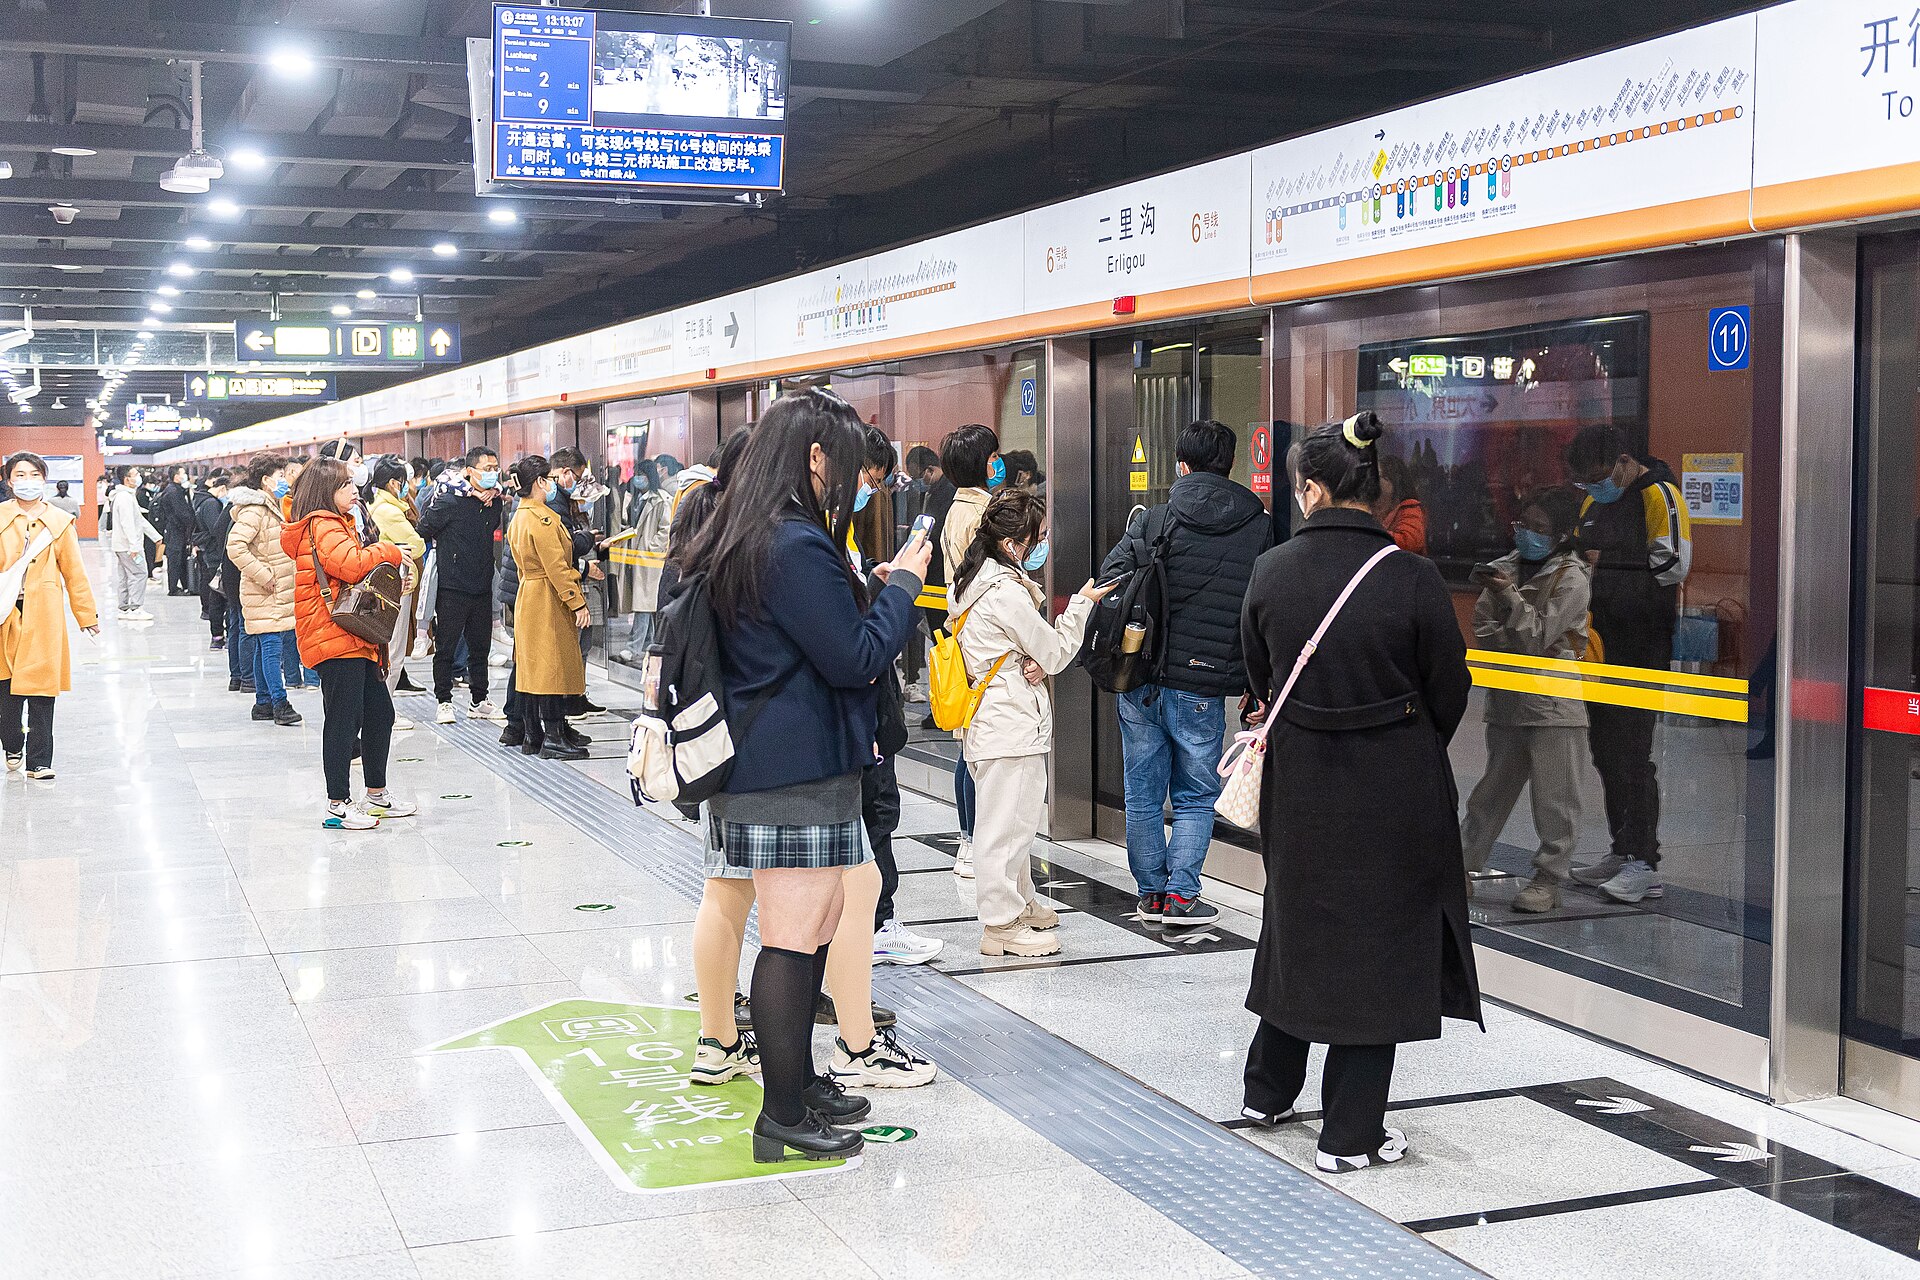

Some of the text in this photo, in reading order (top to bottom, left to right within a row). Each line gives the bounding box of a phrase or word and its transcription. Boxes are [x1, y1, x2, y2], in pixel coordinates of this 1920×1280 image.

[545, 14, 584, 28] 13:13:07
[539, 71, 550, 88] 2
[538, 99, 549, 114] 9
[1882, 90, 1914, 120] To
[1489, 185, 1495, 196] 10
[1503, 182, 1510, 192] 14
[1436, 197, 1440, 206] 8
[1450, 194, 1454, 204] 5
[1463, 191, 1467, 200] 2
[1399, 205, 1403, 213] 2
[1098, 202, 1156, 243] 二里沟
[1107, 252, 1146, 274] Erligou
[363, 332, 377, 348] D
[1720, 324, 1739, 352] 11
[1466, 359, 1481, 376] D
[1024, 390, 1032, 405] 12
[622, 1135, 724, 1154] Line
